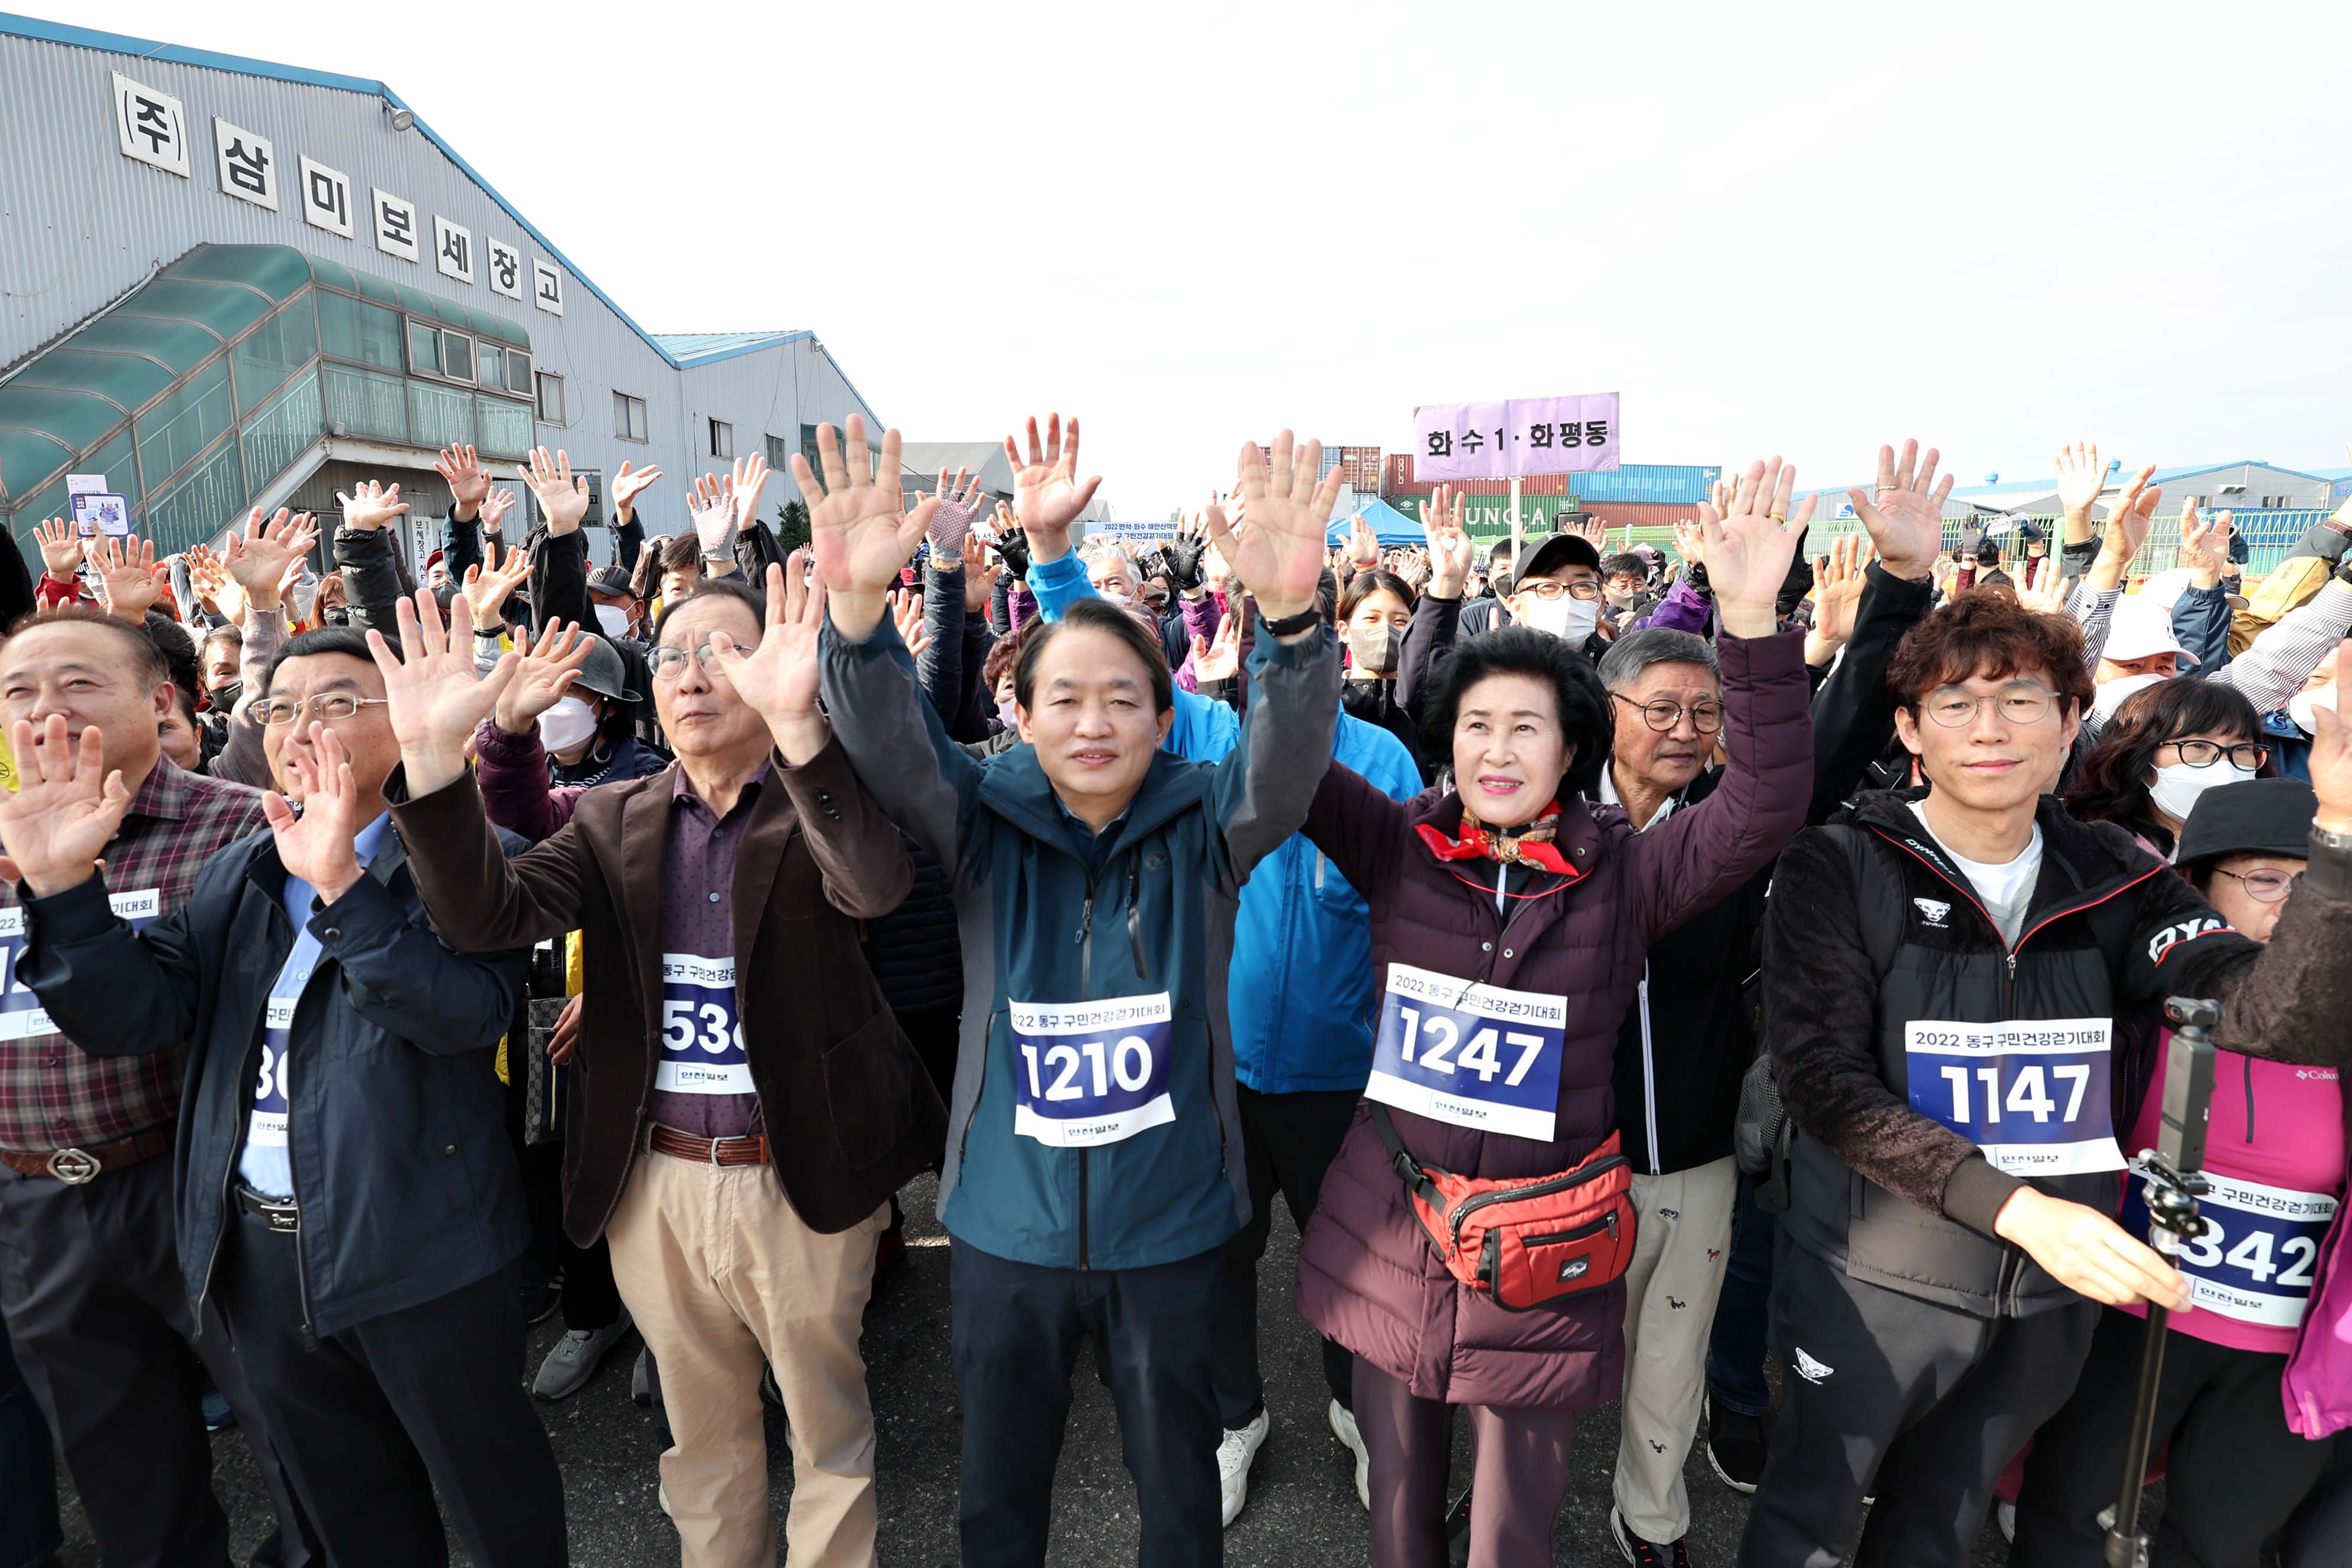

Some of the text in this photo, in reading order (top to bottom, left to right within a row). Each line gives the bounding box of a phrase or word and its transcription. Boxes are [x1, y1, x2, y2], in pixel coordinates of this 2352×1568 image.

[416, 520, 426, 559] 보세창고
[1395, 975, 1561, 1021] 2022 동구 구민건강걷기대회
[1012, 1004, 1165, 1028] 022 동구 구민건강걷기대회
[1400, 1006, 1544, 1087] 1247
[1916, 1030, 2105, 1049] 2022 동구 구민건강걷기대회
[681, 1072, 729, 1081] 인천일보
[1021, 1035, 1152, 1101] 1210
[1941, 1064, 2090, 1124] 1147
[1435, 1100, 1487, 1119] 인천일보
[1069, 1123, 1119, 1136] 인천일보
[2001, 1154, 2059, 1164] 인천일보
[2200, 1286, 2263, 1309] 인천일보
